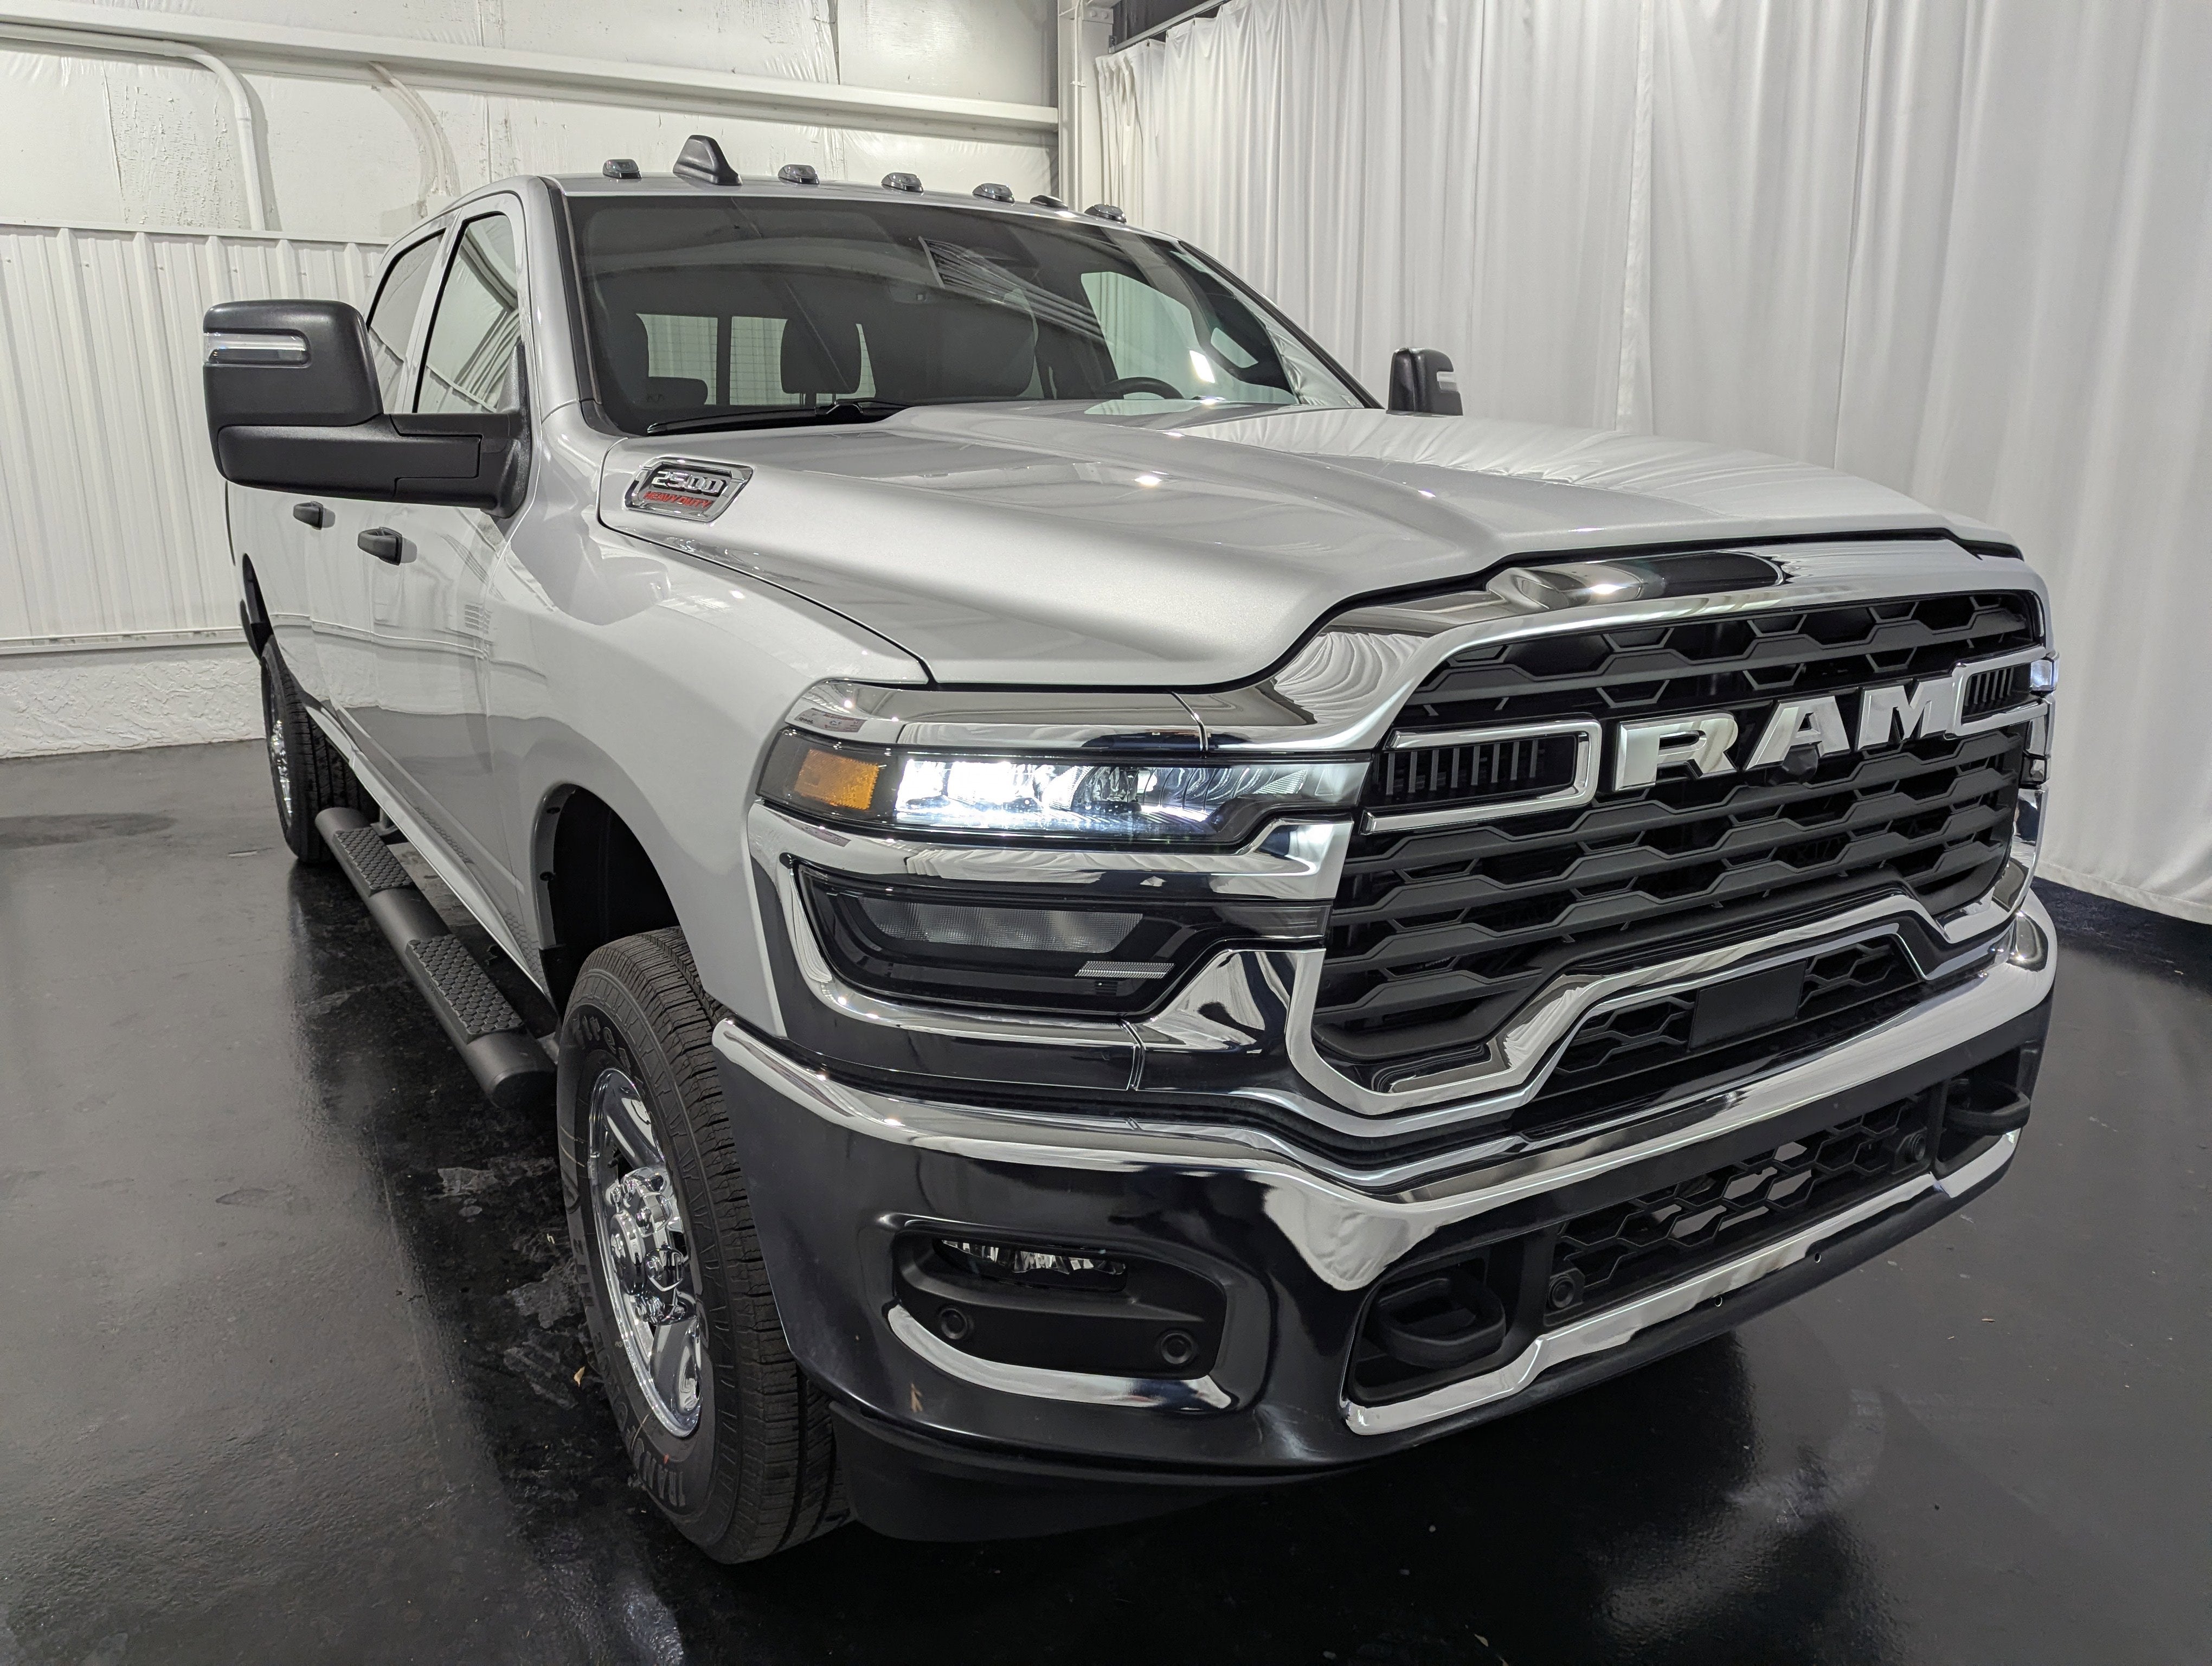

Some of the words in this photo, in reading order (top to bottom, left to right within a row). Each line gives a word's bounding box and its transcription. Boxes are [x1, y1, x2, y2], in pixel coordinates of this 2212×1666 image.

[652, 471, 726, 495] 2500
[643, 491, 679, 503] HEAVY
[678, 495, 713, 508] DUTY
[1613, 677, 1953, 791] RAM
